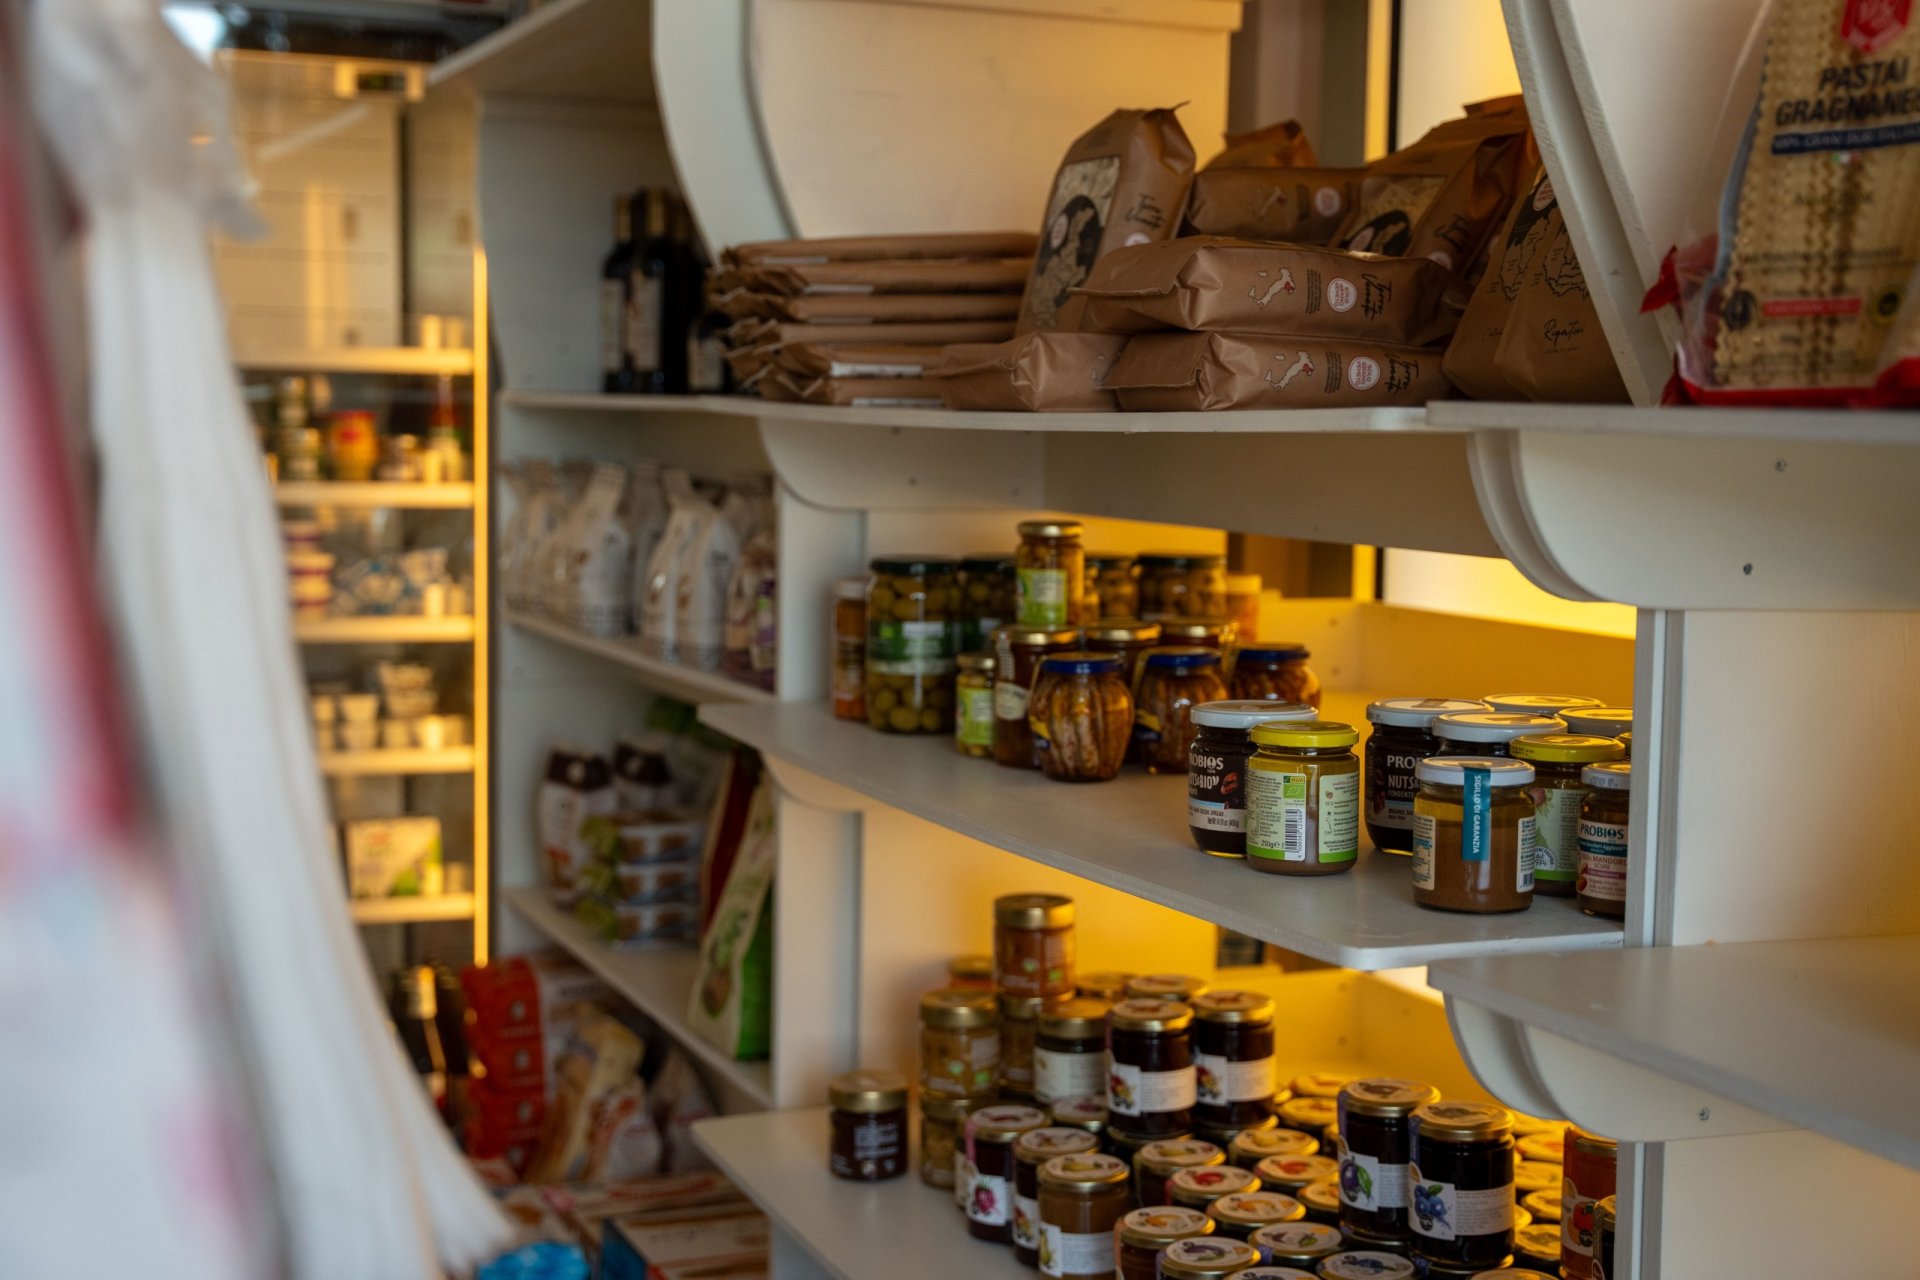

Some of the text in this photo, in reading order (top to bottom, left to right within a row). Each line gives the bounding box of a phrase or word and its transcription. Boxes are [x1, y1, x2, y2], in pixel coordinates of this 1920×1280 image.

[1818, 57, 1910, 92] PASTAI
[1190, 753, 1224, 770] OBIOS
[1472, 775, 1481, 854] SIGILLO DI GARANZIA
[1580, 823, 1625, 840] PROBIOS
